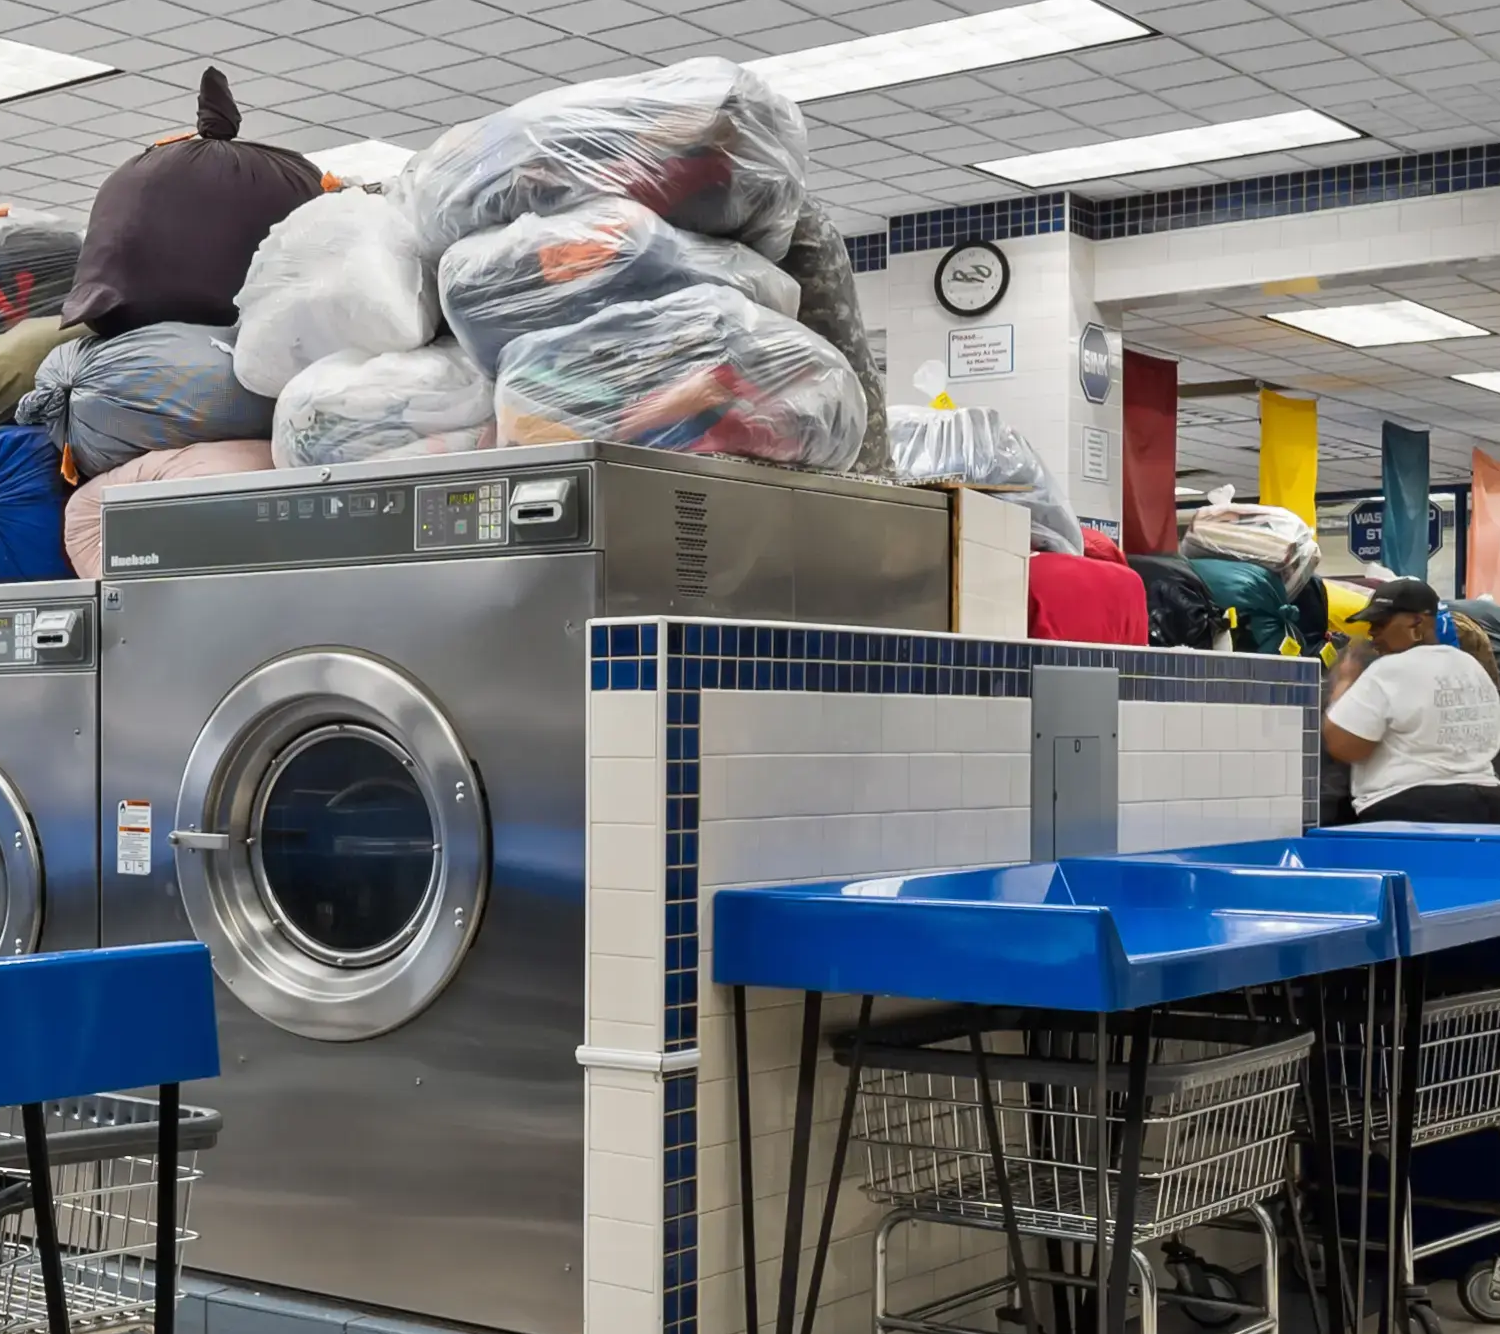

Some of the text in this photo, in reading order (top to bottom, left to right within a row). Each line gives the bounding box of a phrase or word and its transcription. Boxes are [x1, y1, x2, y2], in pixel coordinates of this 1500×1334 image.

[1083, 349, 1108, 377] SINK
[110, 553, 159, 567] Huebsch
[107, 592, 119, 603] 44
